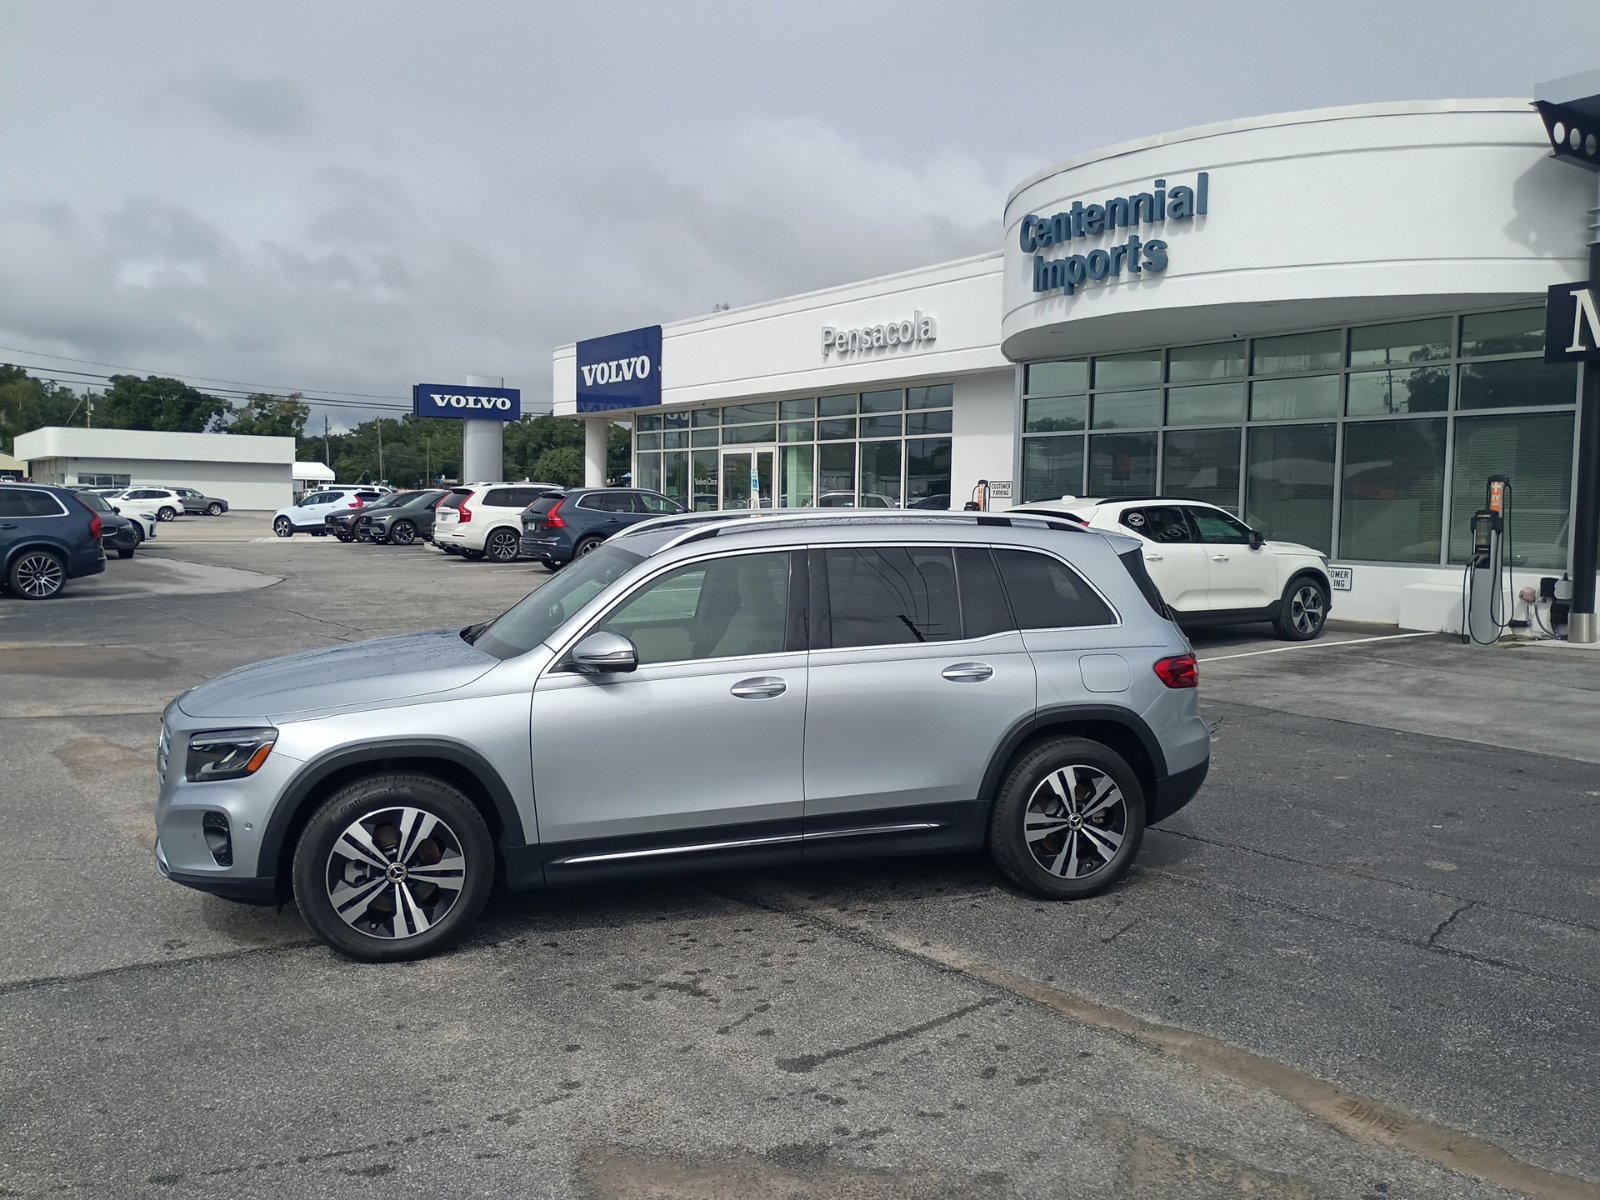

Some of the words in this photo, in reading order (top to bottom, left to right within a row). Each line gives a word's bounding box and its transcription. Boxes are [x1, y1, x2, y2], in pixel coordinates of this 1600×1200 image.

[1020, 172, 1209, 253] Centennial
[1033, 235, 1168, 296] Imports
[821, 310, 936, 356] Pensacola
[581, 355, 651, 387] VOLVO
[430, 394, 512, 410] VOLVO
[1328, 569, 1349, 579] OMER
